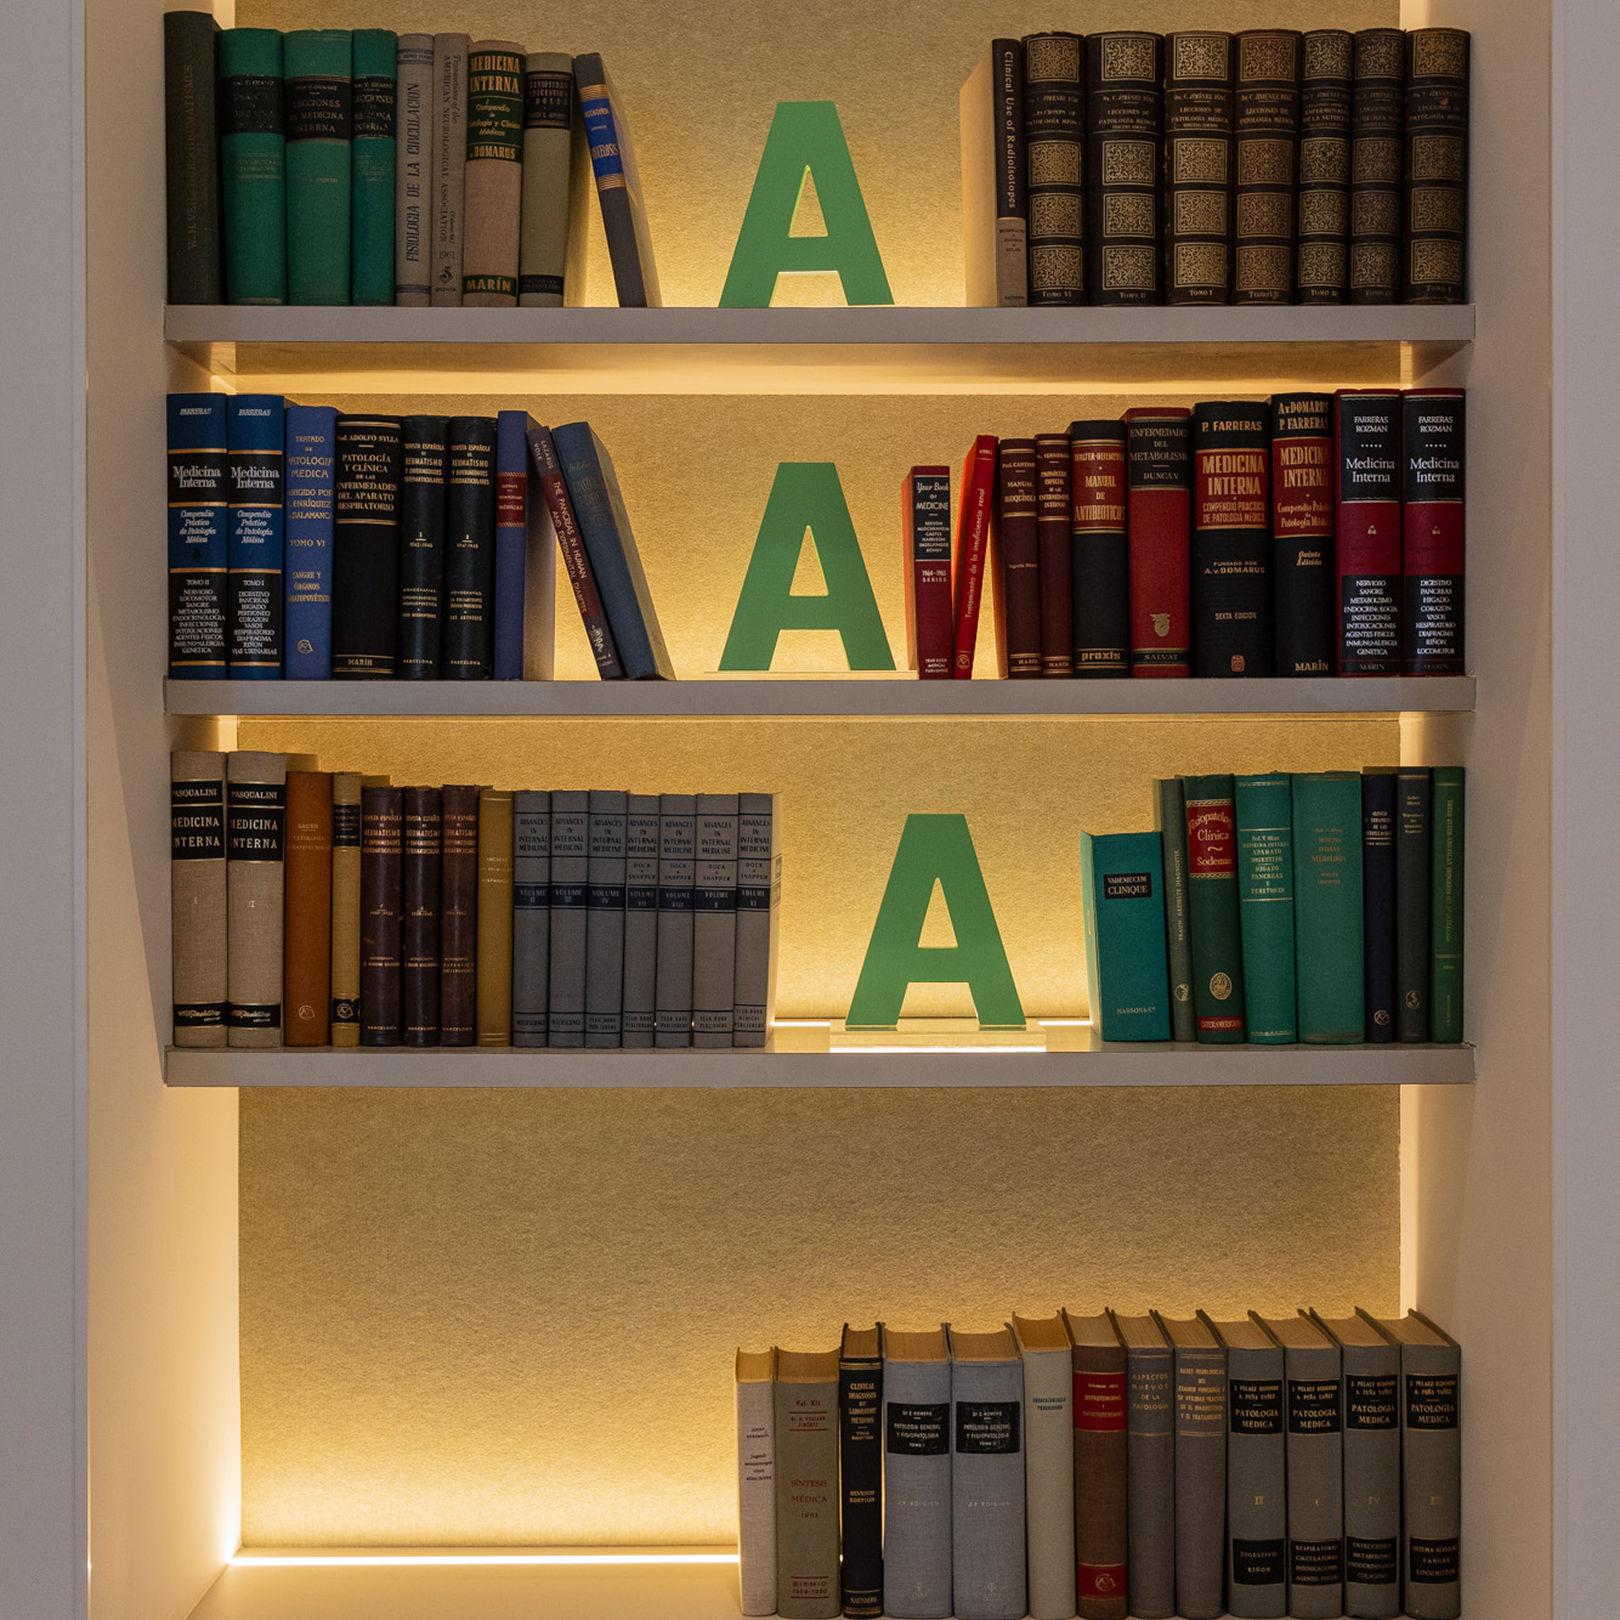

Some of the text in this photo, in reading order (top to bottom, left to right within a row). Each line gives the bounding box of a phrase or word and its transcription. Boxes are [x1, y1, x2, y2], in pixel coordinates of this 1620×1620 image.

[470, 55, 521, 74] MEDICINA
[470, 75, 520, 95] INTERNA
[1003, 51, 1017, 209] Clinical Use of Radioisotopes
[439, 55, 453, 243] AMERICAN NEUROLOGICAL ASSOCIATION
[407, 162, 420, 177] LA
[407, 182, 420, 198] DE
[718, 102, 894, 307] A
[406, 205, 420, 262] FISIOLOGIA
[467, 276, 512, 293] MARÍN
[1279, 416, 1329, 431] P. FARRERAS
[1353, 415, 1389, 424] FARRERAS
[1417, 415, 1453, 424] FARRERAS
[1201, 420, 1263, 433] P. FARRERAS
[1355, 424, 1388, 433] ROZMAN
[1419, 424, 1452, 433] ROZMAN
[349, 434, 377, 443] ADOLFO
[1153, 440, 1169, 448] DEL
[341, 453, 392, 464] PATOLOGÍA
[404, 457, 443, 467] REUMATISMO
[451, 458, 489, 468] REUMATISMO
[1345, 456, 1395, 470] Medicina
[1409, 456, 1459, 470] Medicina
[344, 463, 389, 474] Y CLÍNICA
[1201, 454, 1265, 475] MEDICINA
[172, 465, 222, 478] Medicina
[230, 466, 280, 479] Medicina
[290, 469, 329, 479] MEDICA
[1143, 471, 1179, 481] DUNCAN
[1084, 475, 1118, 488] MANUAL
[1283, 467, 1329, 488] INTERNA
[1351, 470, 1391, 484] Interna
[1415, 470, 1455, 484] Interna
[178, 477, 217, 489] Interna
[236, 478, 276, 490] Interna
[1007, 480, 1034, 489] MANUAL
[1207, 476, 1262, 496] INTERNA
[354, 491, 395, 502] APARATO
[1095, 491, 1106, 501] DE
[337, 502, 395, 512] RESPIRATORIO
[915, 501, 949, 511] MEDICINE
[1276, 502, 1312, 517] Compendio
[1202, 513, 1212, 524] DE
[552, 479, 588, 580] THE PANCREAS IN HUMAN
[289, 539, 326, 547] TOMO VI
[965, 488, 986, 619] Tratamiento de la insuficiencia renal
[551, 509, 588, 614] AND EXPERIMENTAL DIABETES
[718, 463, 894, 670] A
[243, 579, 261, 587] TOMO
[1355, 579, 1387, 587] NERVIOSO
[1419, 579, 1453, 587] DIGESTIVO
[183, 588, 214, 596] NERVIOSO
[1422, 596, 1450, 604] HIGADO
[1419, 604, 1452, 612] CORAZON
[1350, 614, 1392, 622] INFECCIONES
[1426, 613, 1446, 621] VASOS
[1080, 650, 1121, 662] praxis
[1356, 648, 1388, 656] GENETICA
[1416, 647, 1456, 655] LOCOMOTOR
[1143, 654, 1179, 662] SALVAT
[1294, 659, 1329, 672] MARÍN
[518, 835, 548, 843] INTERNAL
[553, 835, 584, 843] INTERNAL
[627, 836, 657, 845] INTERNAL
[740, 836, 770, 844] INTERNAL
[1196, 829, 1230, 842] Clínica
[592, 837, 622, 845] INTERNAL
[663, 838, 693, 846] INTERNAL
[701, 838, 732, 846] INTERNAL
[519, 844, 548, 852] MEDICINE
[554, 844, 583, 852] MEDICINE
[592, 845, 622, 853] MEDICINE
[627, 845, 657, 853] MEDICINE
[663, 846, 693, 855] MEDICINE
[701, 847, 732, 855] MEDICINE
[740, 845, 770, 853] MEDICINE
[1107, 885, 1149, 896] CLINIQUE
[847, 815, 1025, 1029] A
[1140, 1393, 1161, 1401] DE LA
[1235, 1408, 1279, 1418] PATOLOGIA
[1292, 1408, 1337, 1418] PATOLOGIA
[1351, 1403, 1396, 1413] PATOLOGIA
[1410, 1403, 1456, 1413] PATOLOGIA
[1241, 1419, 1274, 1429] MEDICA
[1299, 1419, 1332, 1429] MEDICA
[1357, 1415, 1391, 1424] MEDICA
[1417, 1414, 1451, 1424] MEDICA
[791, 1493, 828, 1504] MÉDICA
